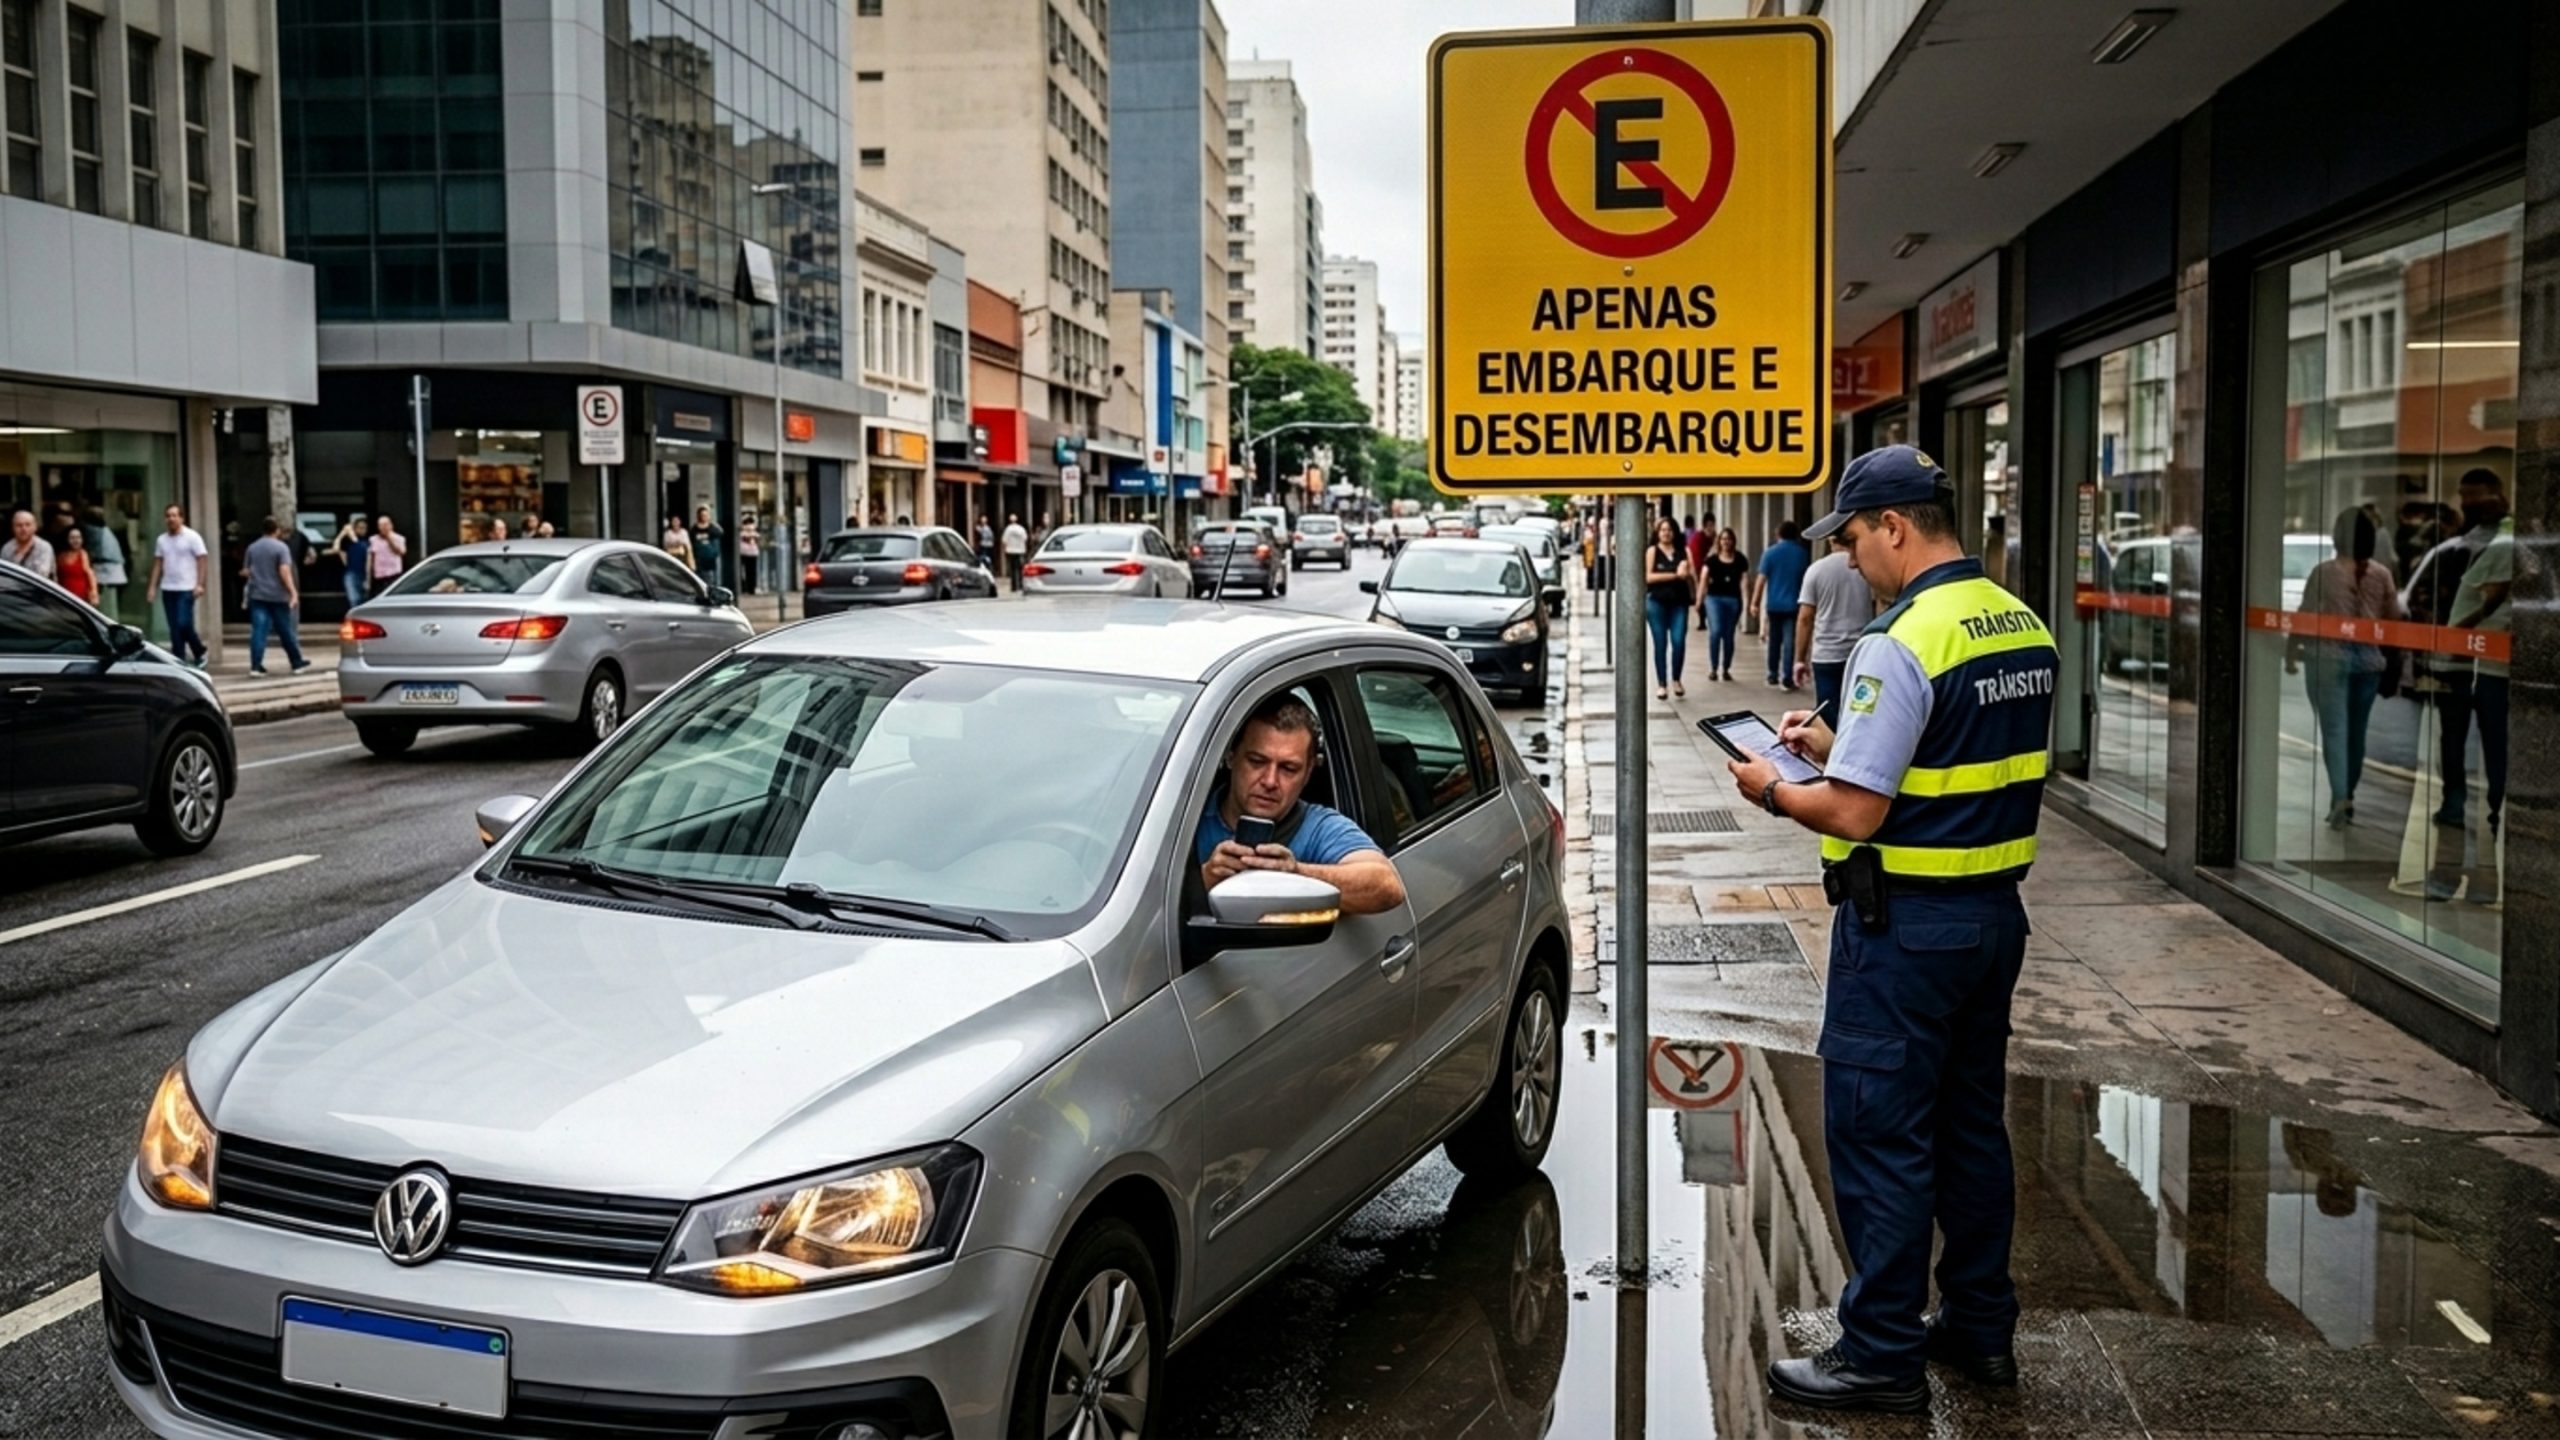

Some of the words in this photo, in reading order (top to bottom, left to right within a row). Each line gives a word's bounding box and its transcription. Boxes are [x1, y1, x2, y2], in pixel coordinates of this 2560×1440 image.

[1594, 97, 1665, 211] E
[1532, 284, 1717, 331] APENAS
[1478, 347, 1736, 395] EMBARQUE
[1753, 347, 1778, 390] E
[593, 397, 608, 419] E
[1455, 409, 1804, 457] DESEMBARQUE
